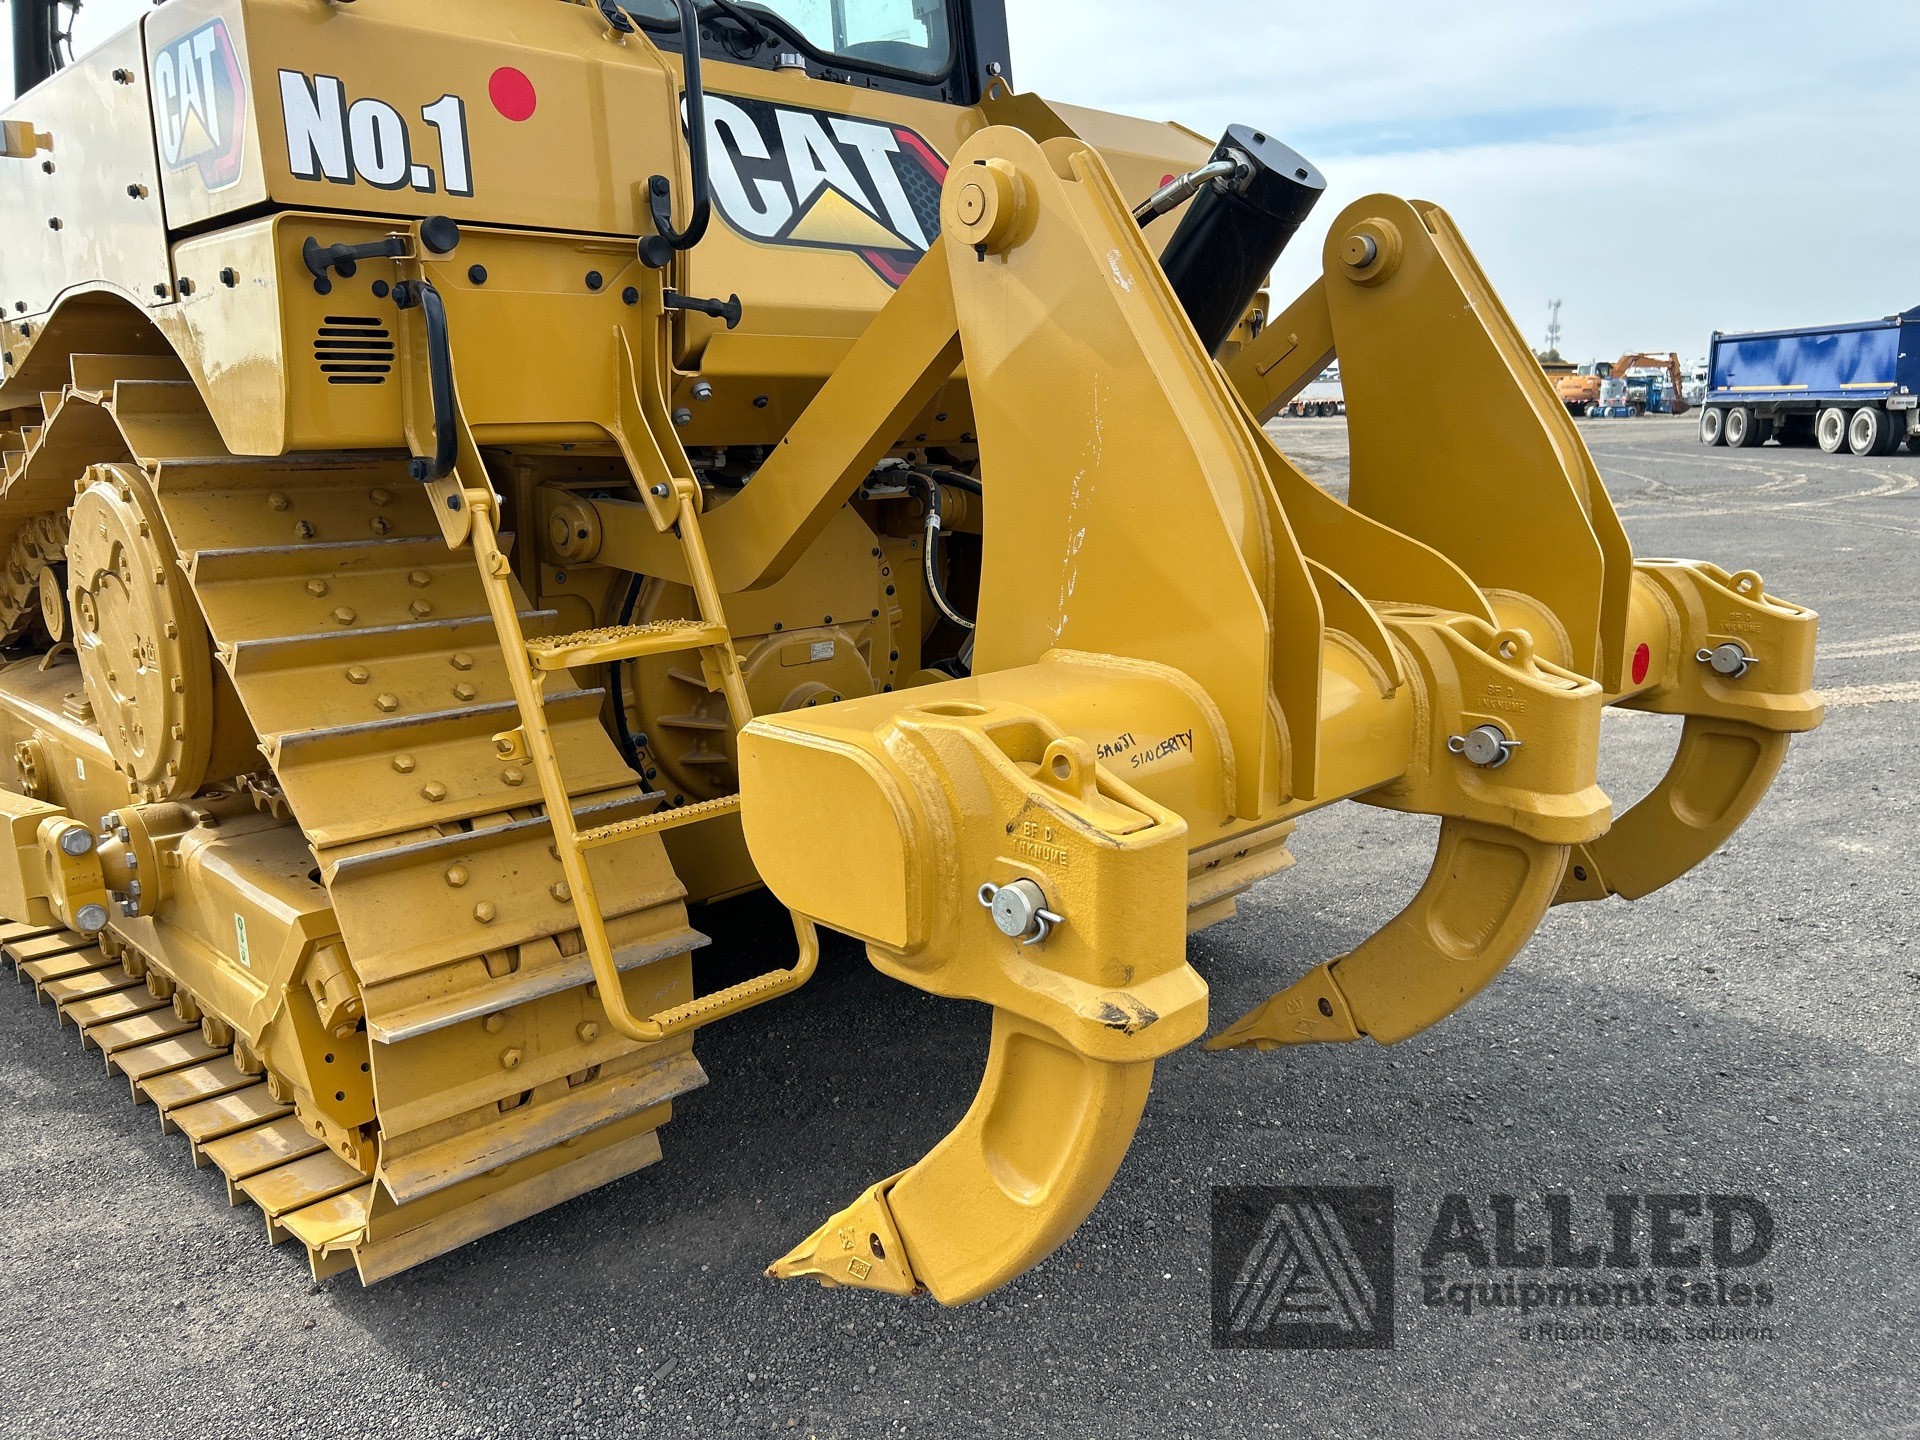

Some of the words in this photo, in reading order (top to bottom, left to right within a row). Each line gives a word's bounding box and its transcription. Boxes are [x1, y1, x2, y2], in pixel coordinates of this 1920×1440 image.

[155, 25, 220, 164] CAT
[277, 68, 474, 197] No.1
[680, 94, 930, 251] CAT
